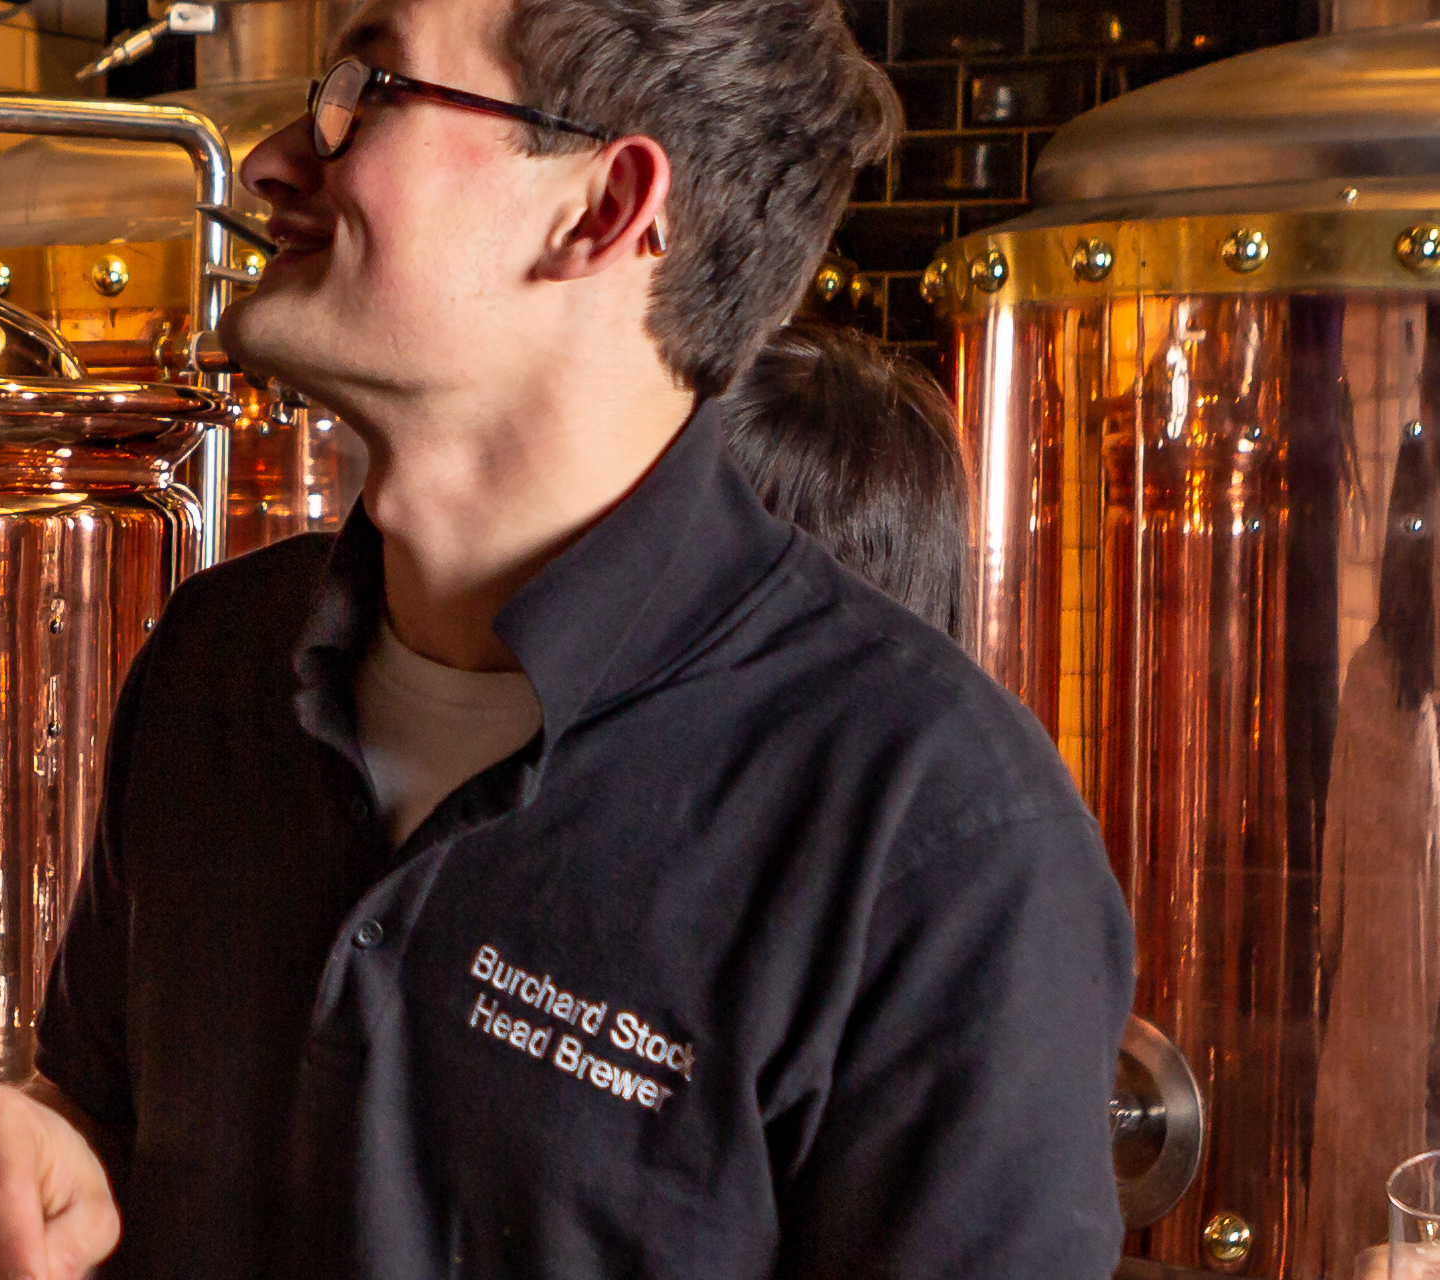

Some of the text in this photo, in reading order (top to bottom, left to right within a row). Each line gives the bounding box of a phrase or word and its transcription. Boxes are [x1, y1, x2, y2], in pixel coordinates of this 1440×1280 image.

[471, 944, 608, 1036] Burchard
[469, 992, 673, 1113] Head Brewer
